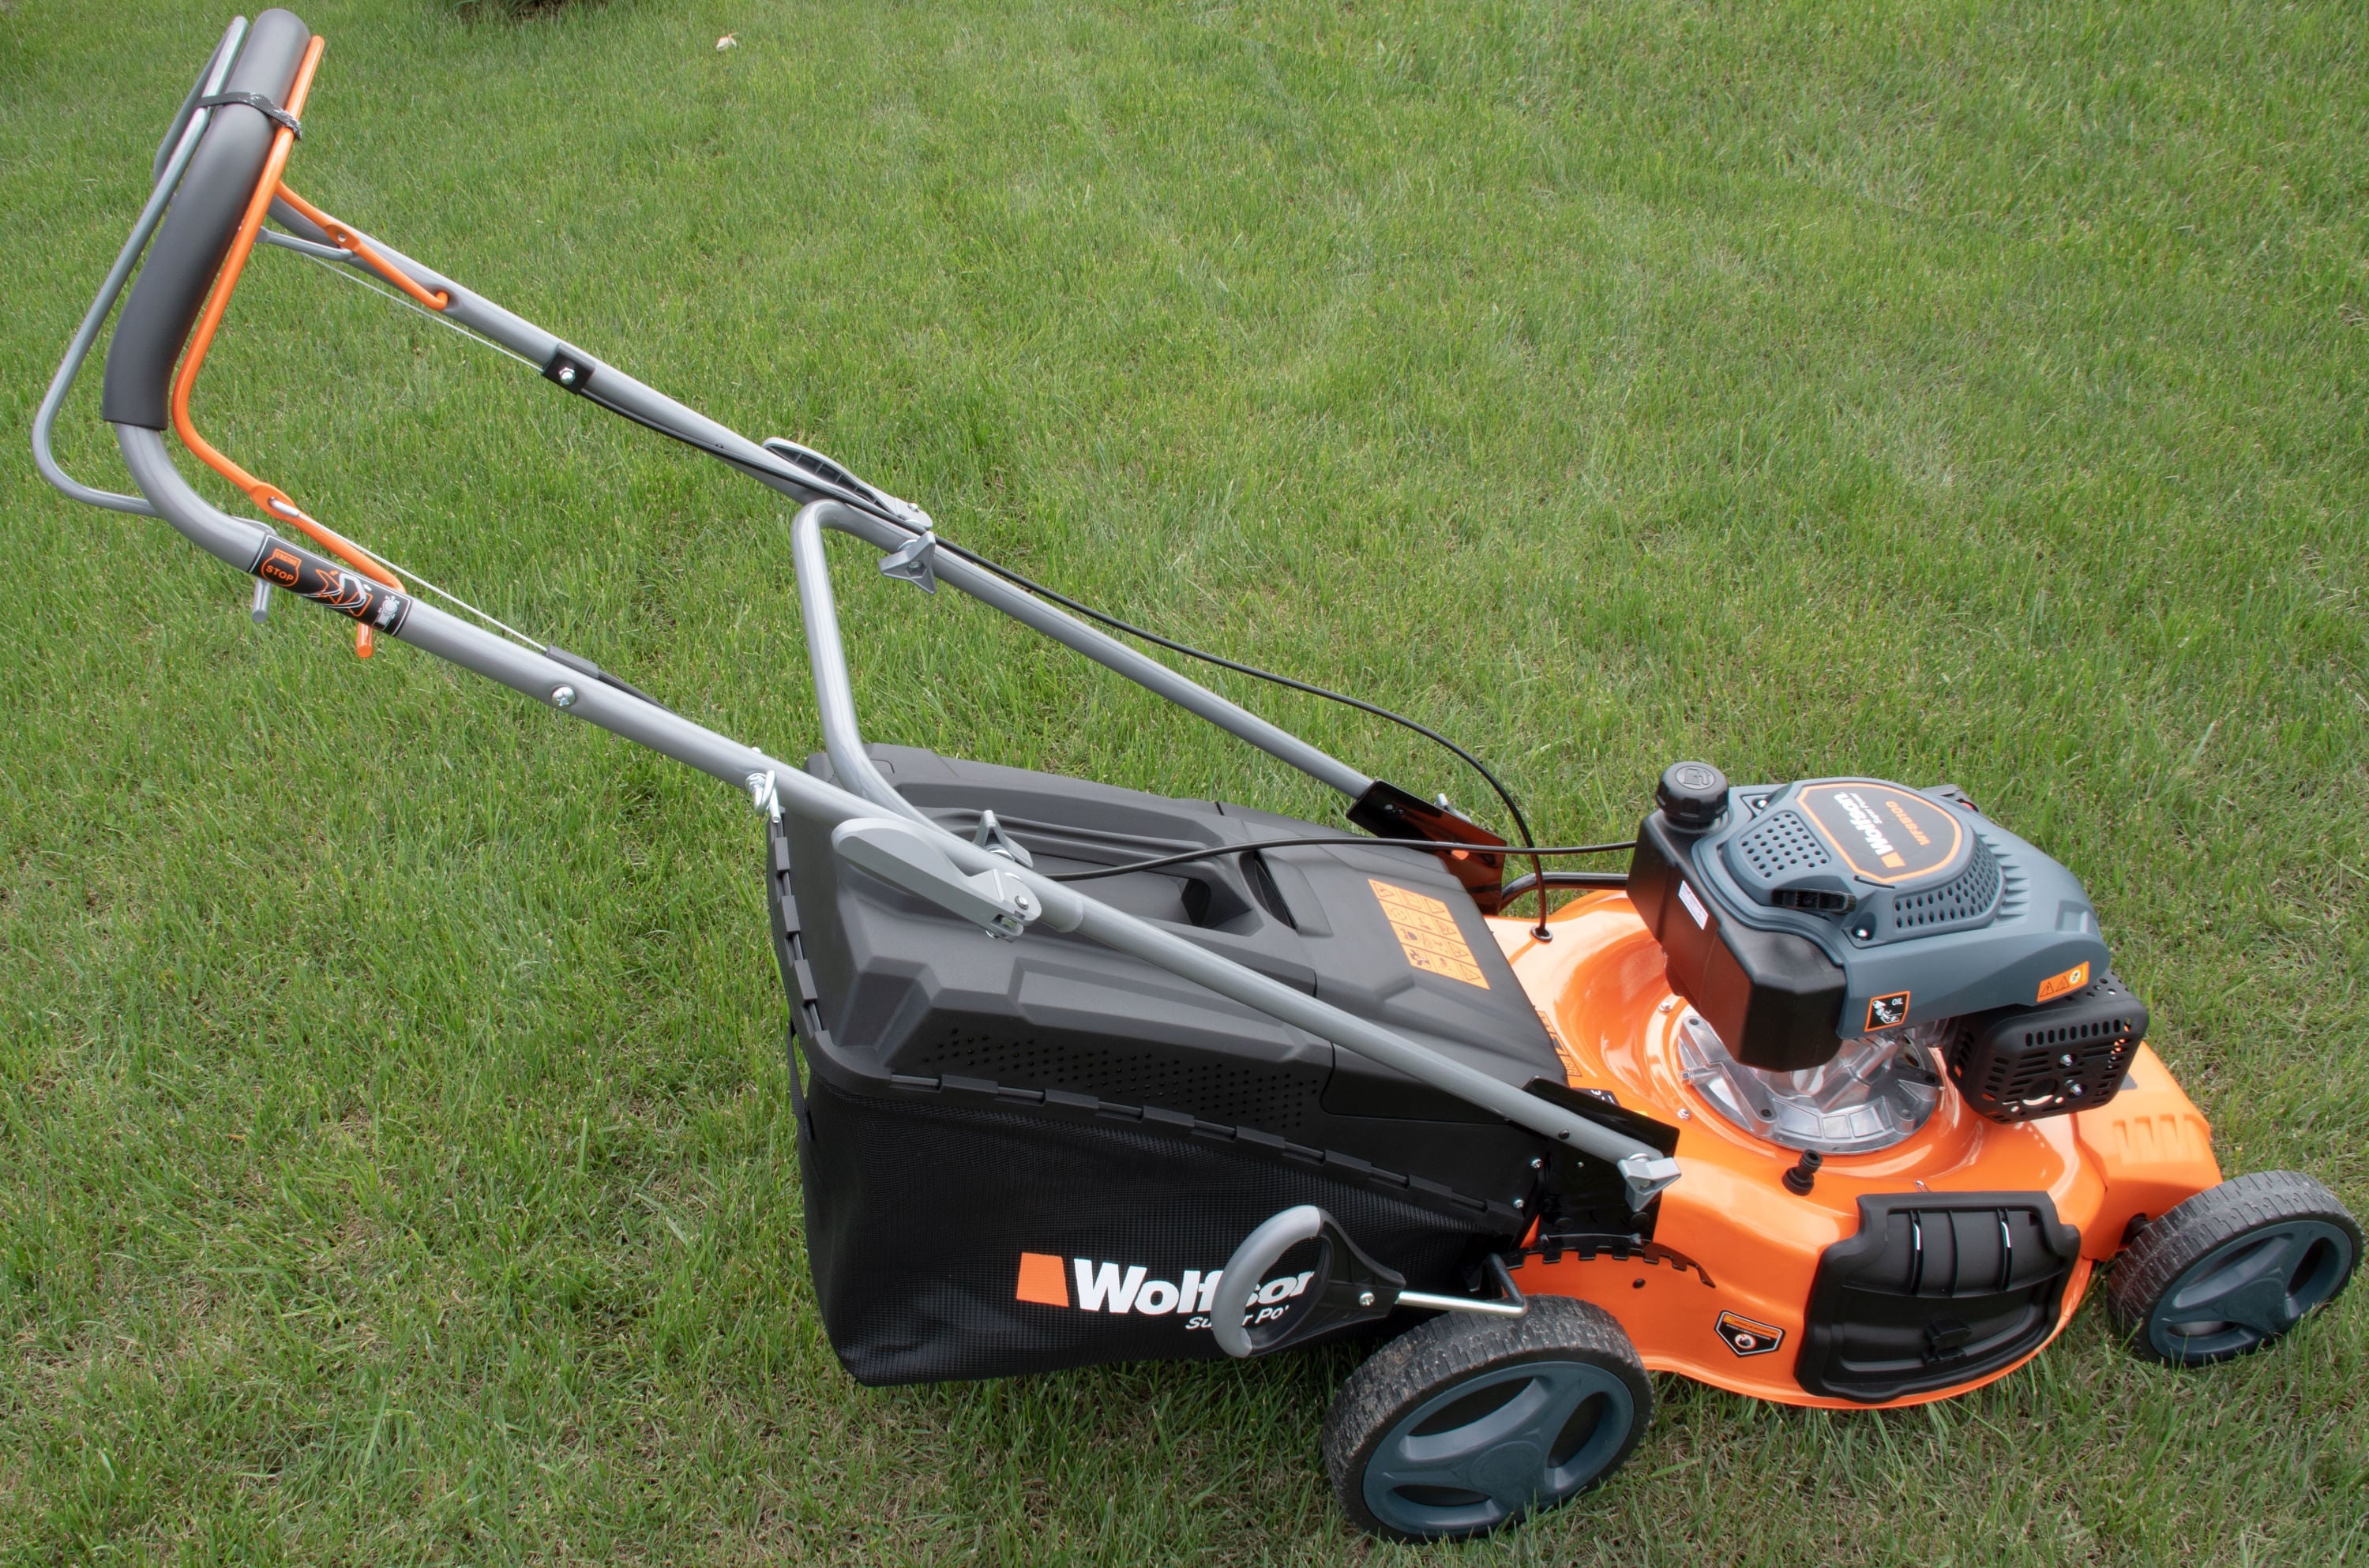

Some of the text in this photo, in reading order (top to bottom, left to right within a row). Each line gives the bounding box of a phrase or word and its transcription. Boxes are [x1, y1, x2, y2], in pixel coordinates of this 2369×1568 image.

[265, 565, 294, 581] STOP
[1834, 793, 1894, 856] Wolfson
[1891, 997, 1903, 1006] OIL
